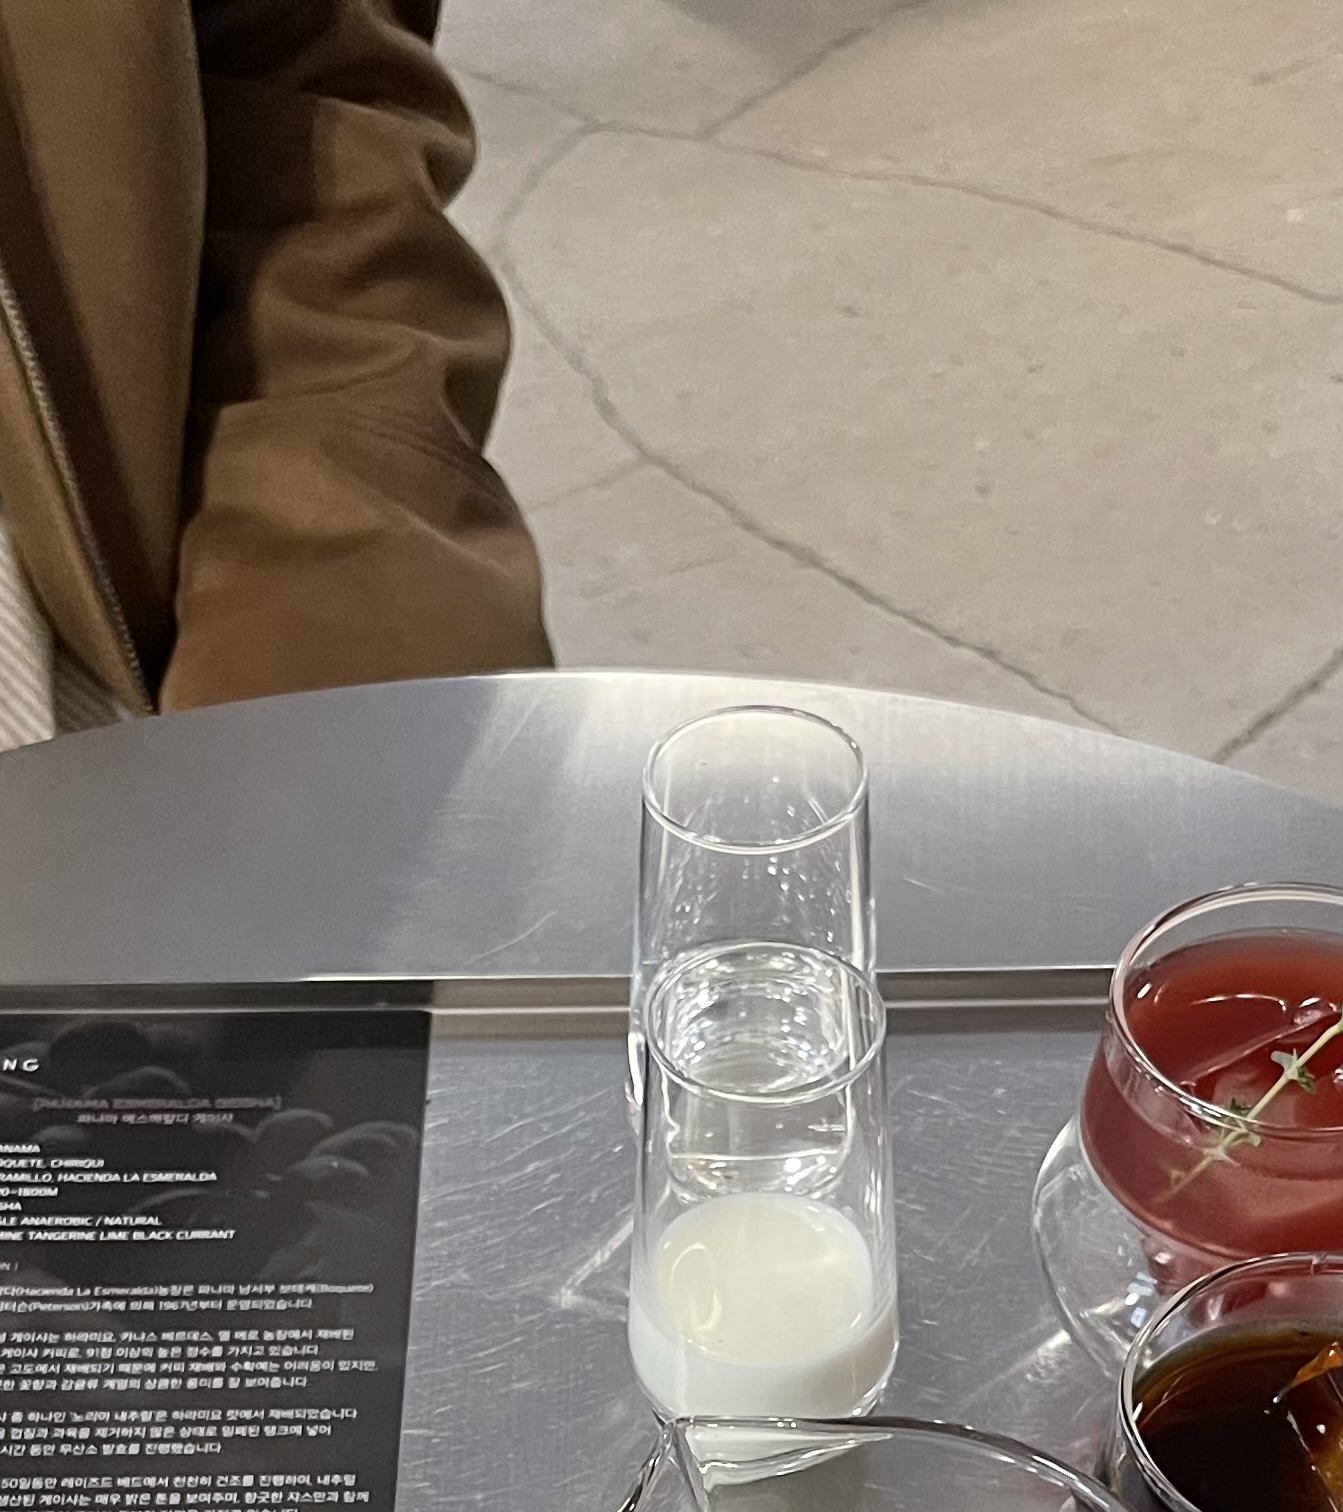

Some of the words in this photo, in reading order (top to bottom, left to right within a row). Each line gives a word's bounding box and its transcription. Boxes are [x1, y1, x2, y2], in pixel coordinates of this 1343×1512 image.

[57, 1172, 121, 1182] HACIENDA
[123, 1172, 140, 1182] LA
[142, 1172, 218, 1182] ESMERALDA
[20, 1216, 94, 1226] ANAEROBIC
[104, 1216, 162, 1226] NATURAL
[27, 1230, 96, 1241] TANGERINE
[99, 1230, 130, 1241] LIME
[132, 1230, 173, 1241] BLACK
[176, 1230, 236, 1241] CURRANT
